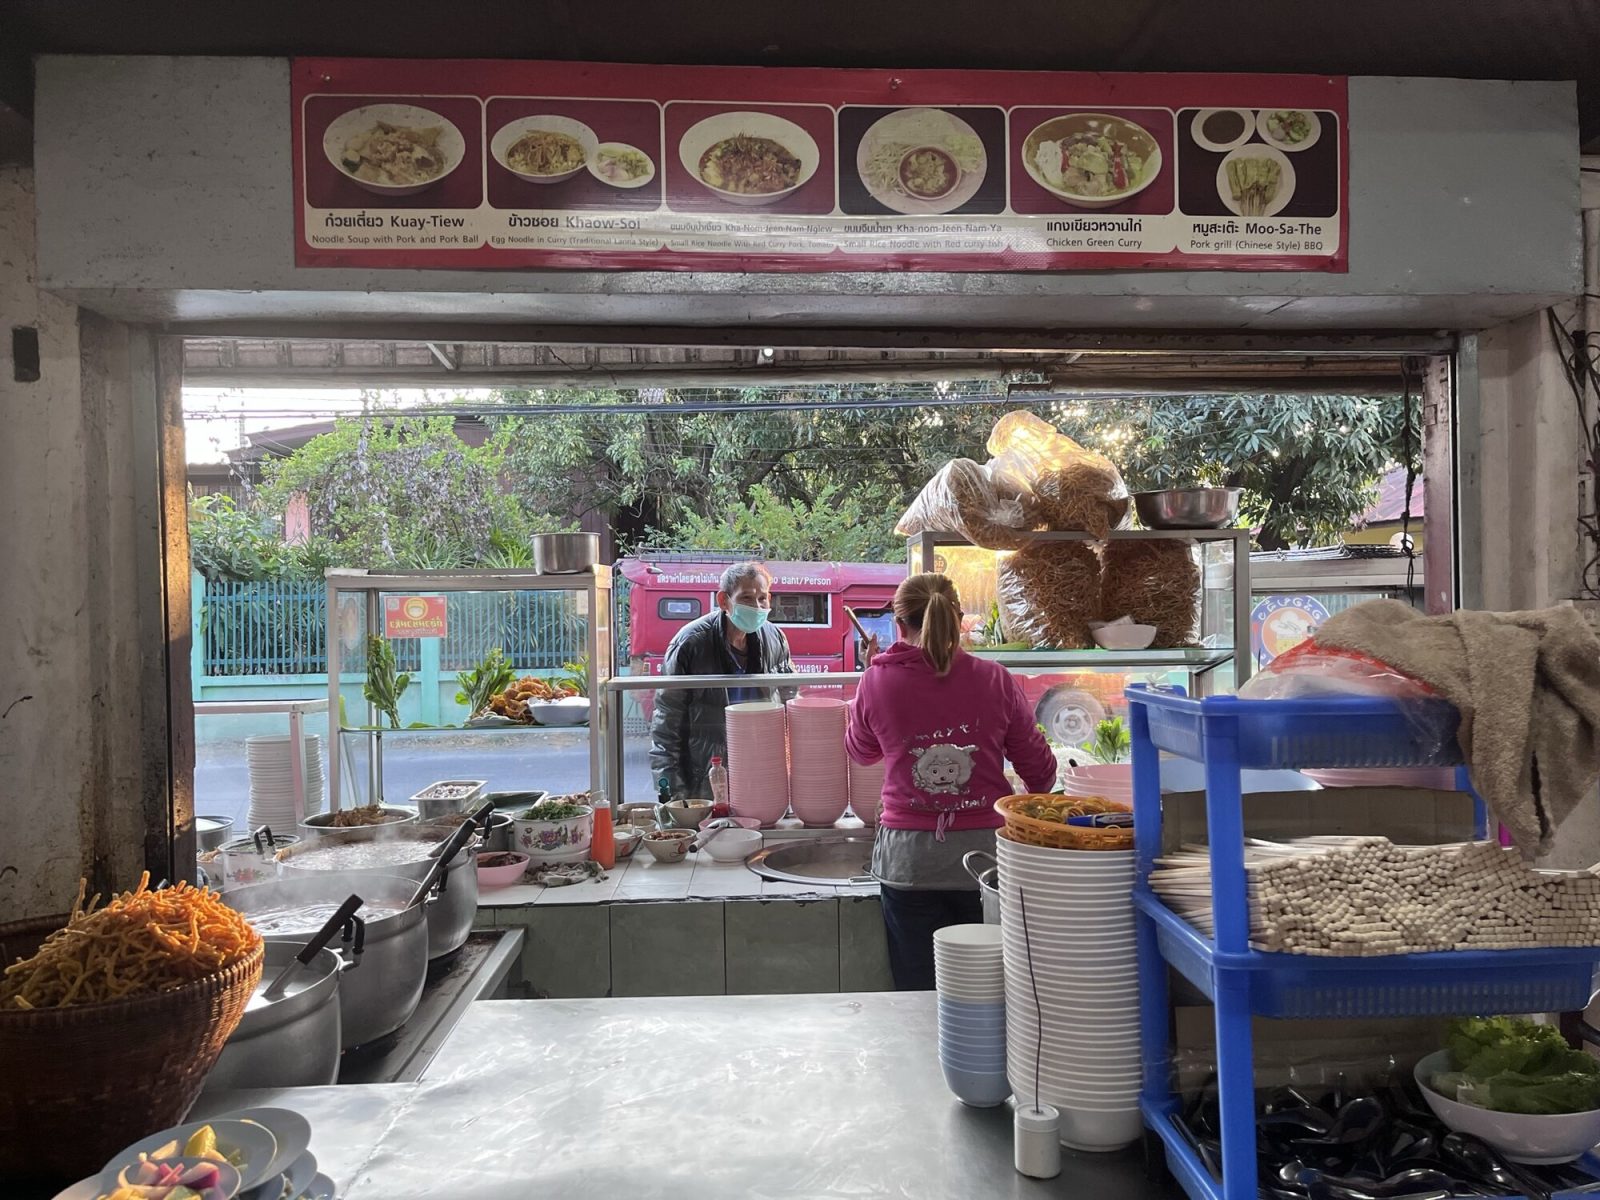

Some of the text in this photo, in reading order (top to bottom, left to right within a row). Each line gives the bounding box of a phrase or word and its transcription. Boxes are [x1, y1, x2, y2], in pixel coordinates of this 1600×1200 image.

[390, 215, 465, 230] Kuay-Tiew
[508, 213, 559, 228] ข้าวซอย
[565, 215, 641, 230] Khaow-Soi
[1046, 218, 1142, 232] แกงเขียวหวานไก่
[1192, 220, 1239, 236] หมูสะเต๊ะ
[1245, 222, 1322, 235] Moo-Sa-The
[312, 234, 479, 245] Noodle Soup with Pork and Pork Ball
[491, 235, 505, 244] Egg
[508, 235, 534, 243] Noodle
[537, 235, 544, 243] in
[547, 236, 567, 245] Curry
[639, 238, 659, 247] Style)
[844, 240, 867, 248] Small
[870, 240, 887, 248] Rice
[889, 240, 920, 249] Noodle
[923, 240, 942, 248] with
[945, 240, 961, 248] Red
[1046, 238, 1142, 249] Chicken Green Curry
[1190, 240, 1323, 251] Pork grill (Chinese Style) BBQ
[781, 576, 832, 587] Baht/Person
